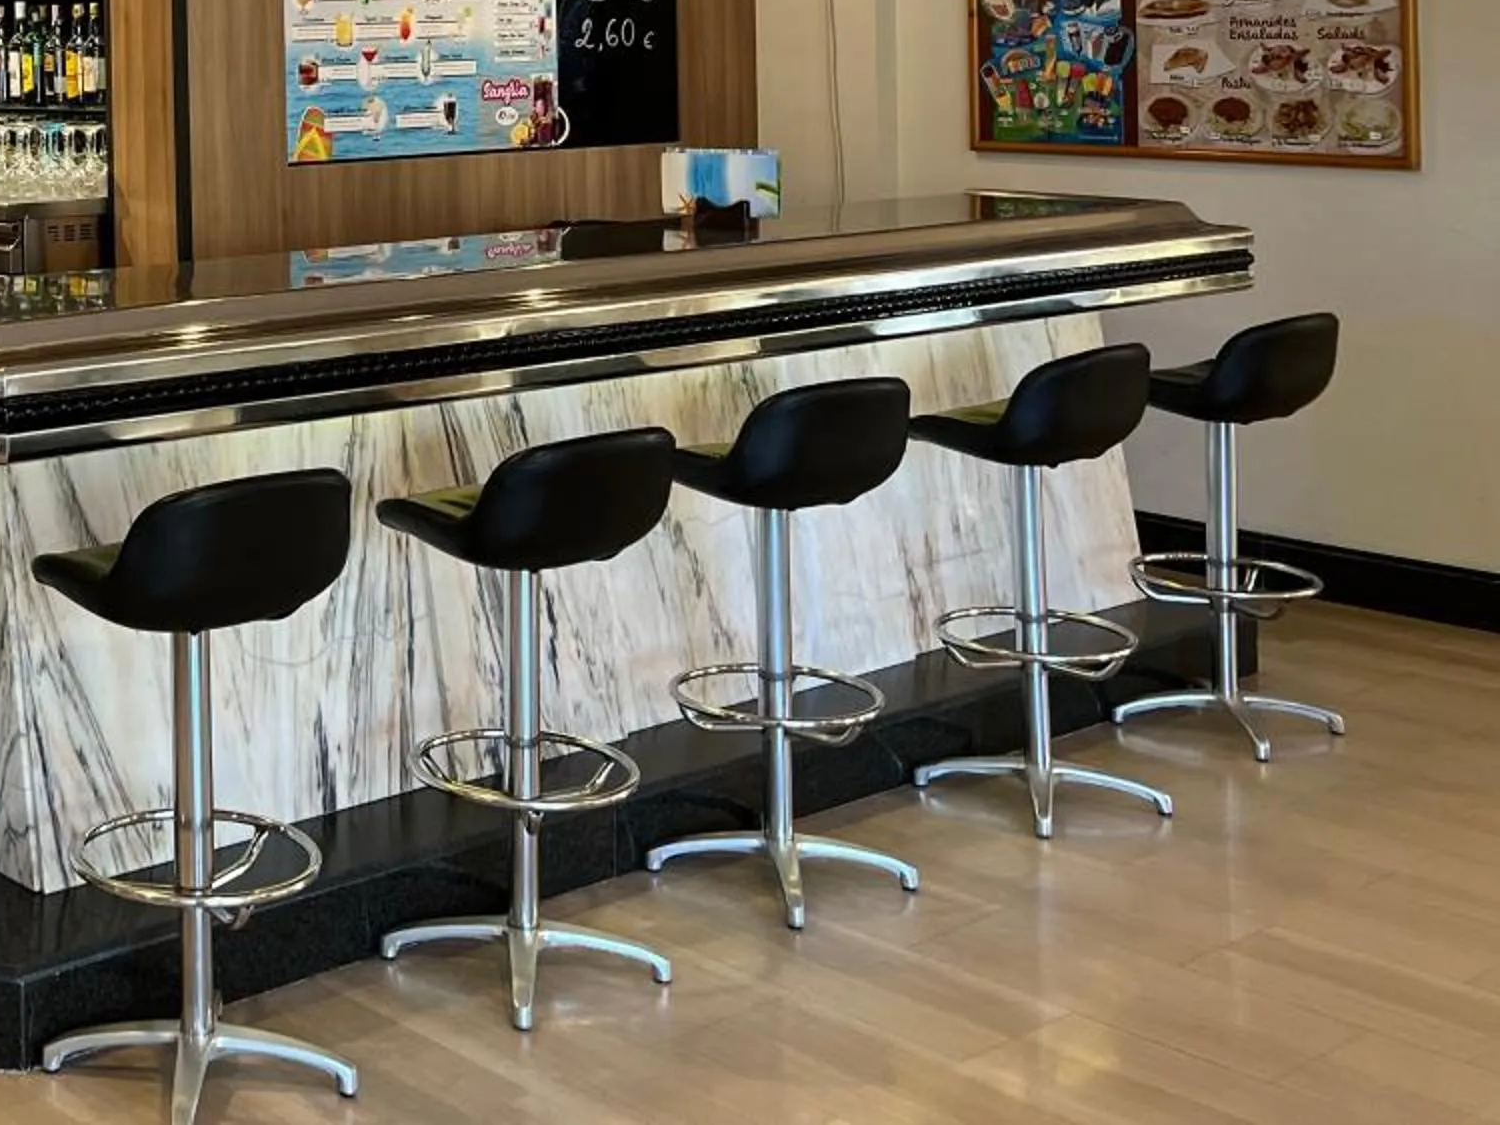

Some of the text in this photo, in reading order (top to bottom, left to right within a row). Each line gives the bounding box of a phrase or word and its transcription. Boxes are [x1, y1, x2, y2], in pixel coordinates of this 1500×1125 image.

[574, 18, 655, 52] 2,60 €
[1229, 26, 1365, 41] Ensaladas Salads
[1221, 78, 1251, 90] Pasta
